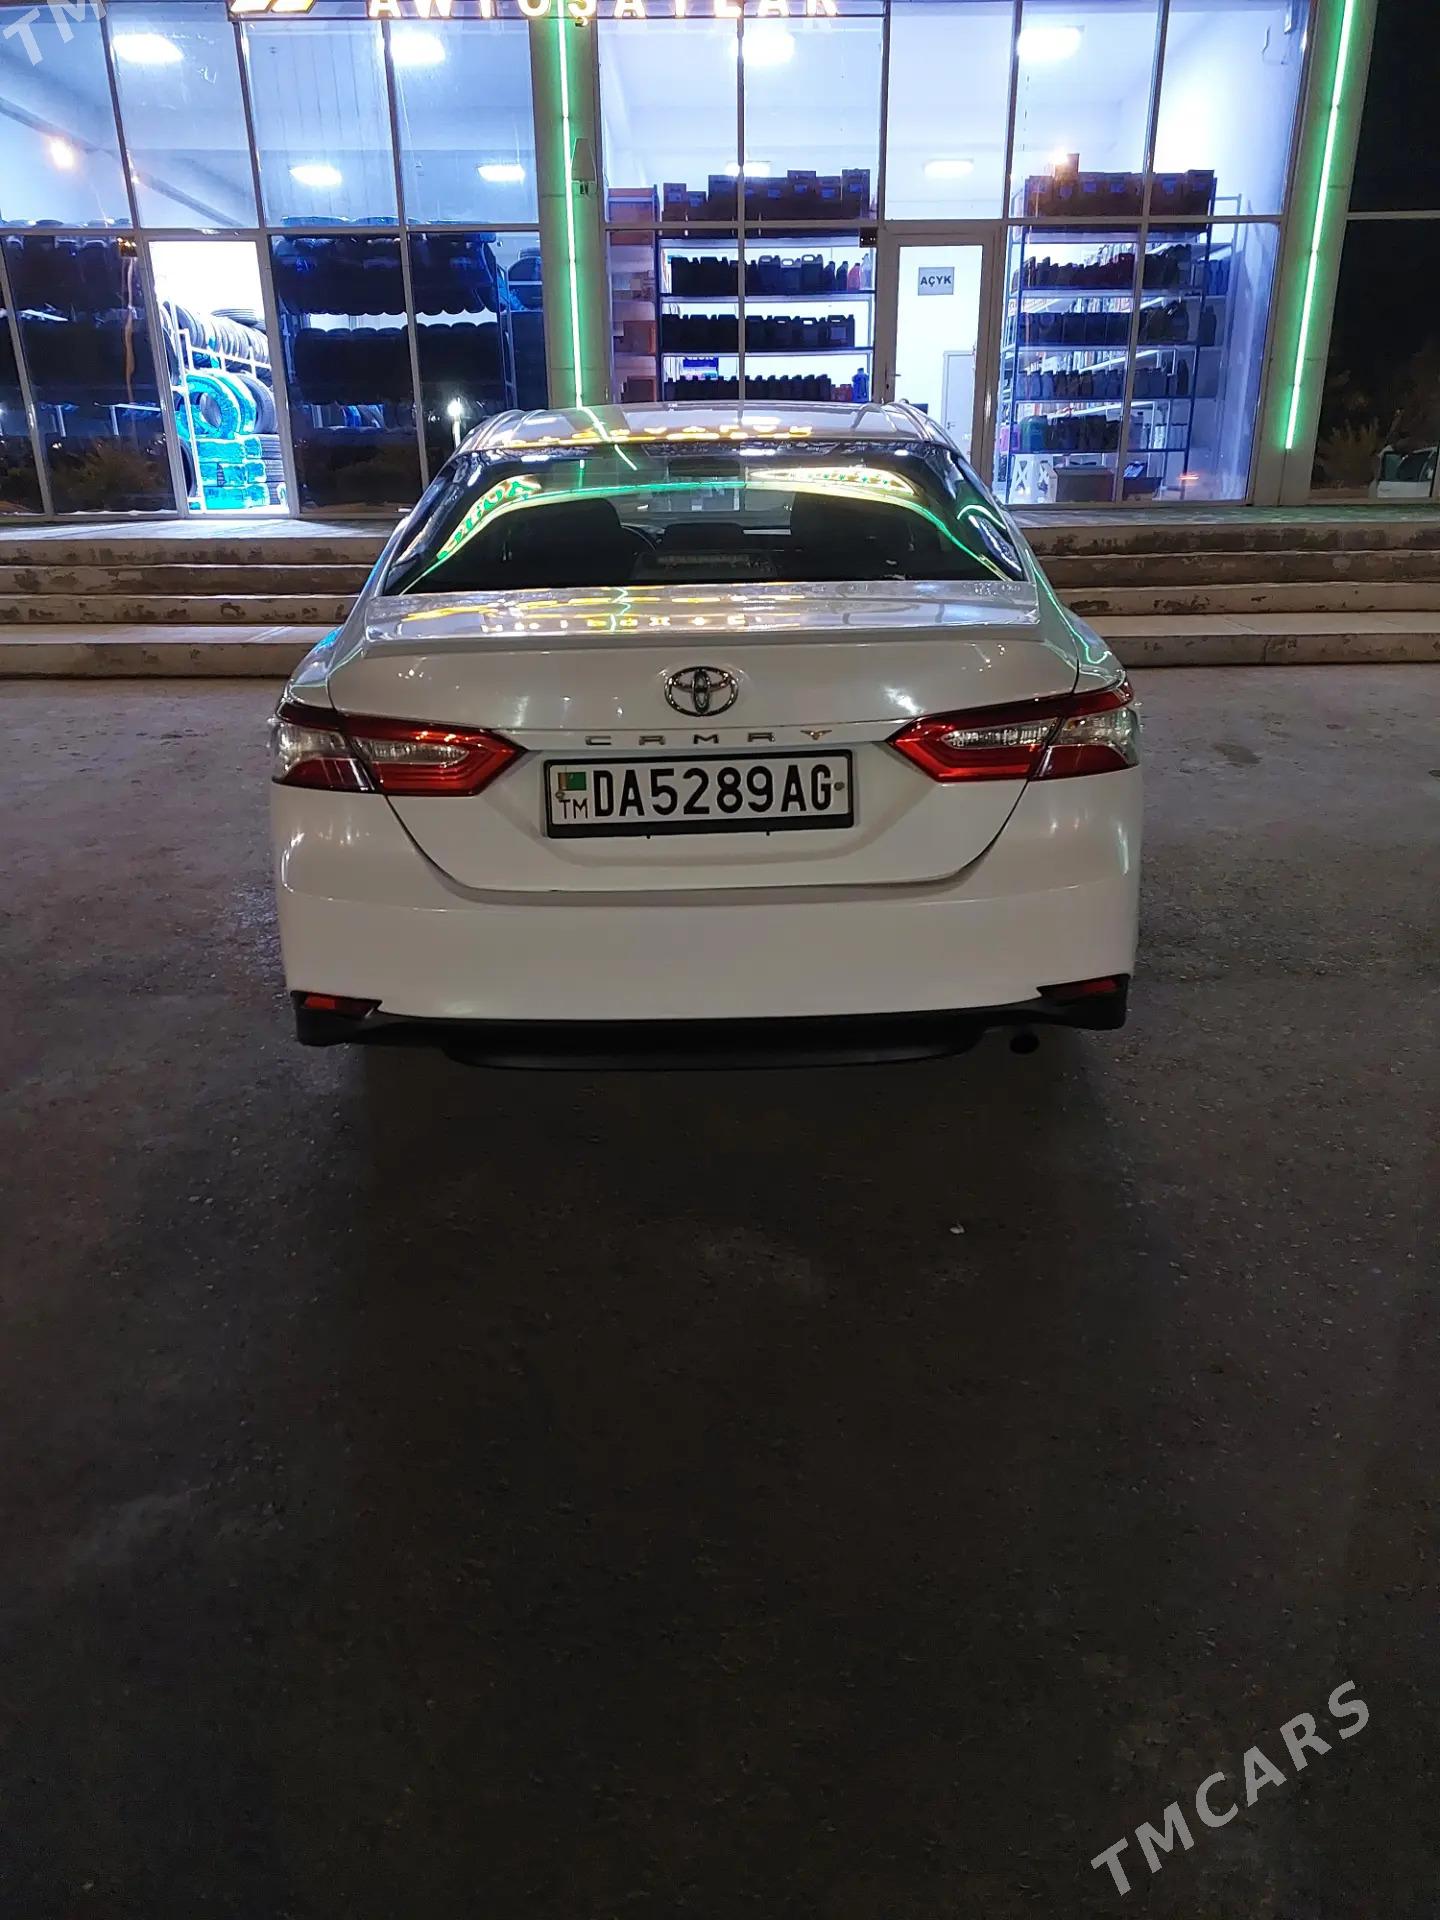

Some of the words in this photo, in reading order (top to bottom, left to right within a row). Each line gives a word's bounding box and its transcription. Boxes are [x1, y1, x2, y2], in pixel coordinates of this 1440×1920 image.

[920, 275, 952, 288] AÇYK
[584, 729, 832, 746] CAMRY
[559, 798, 588, 819] TM
[593, 764, 832, 817] DA5289AG
